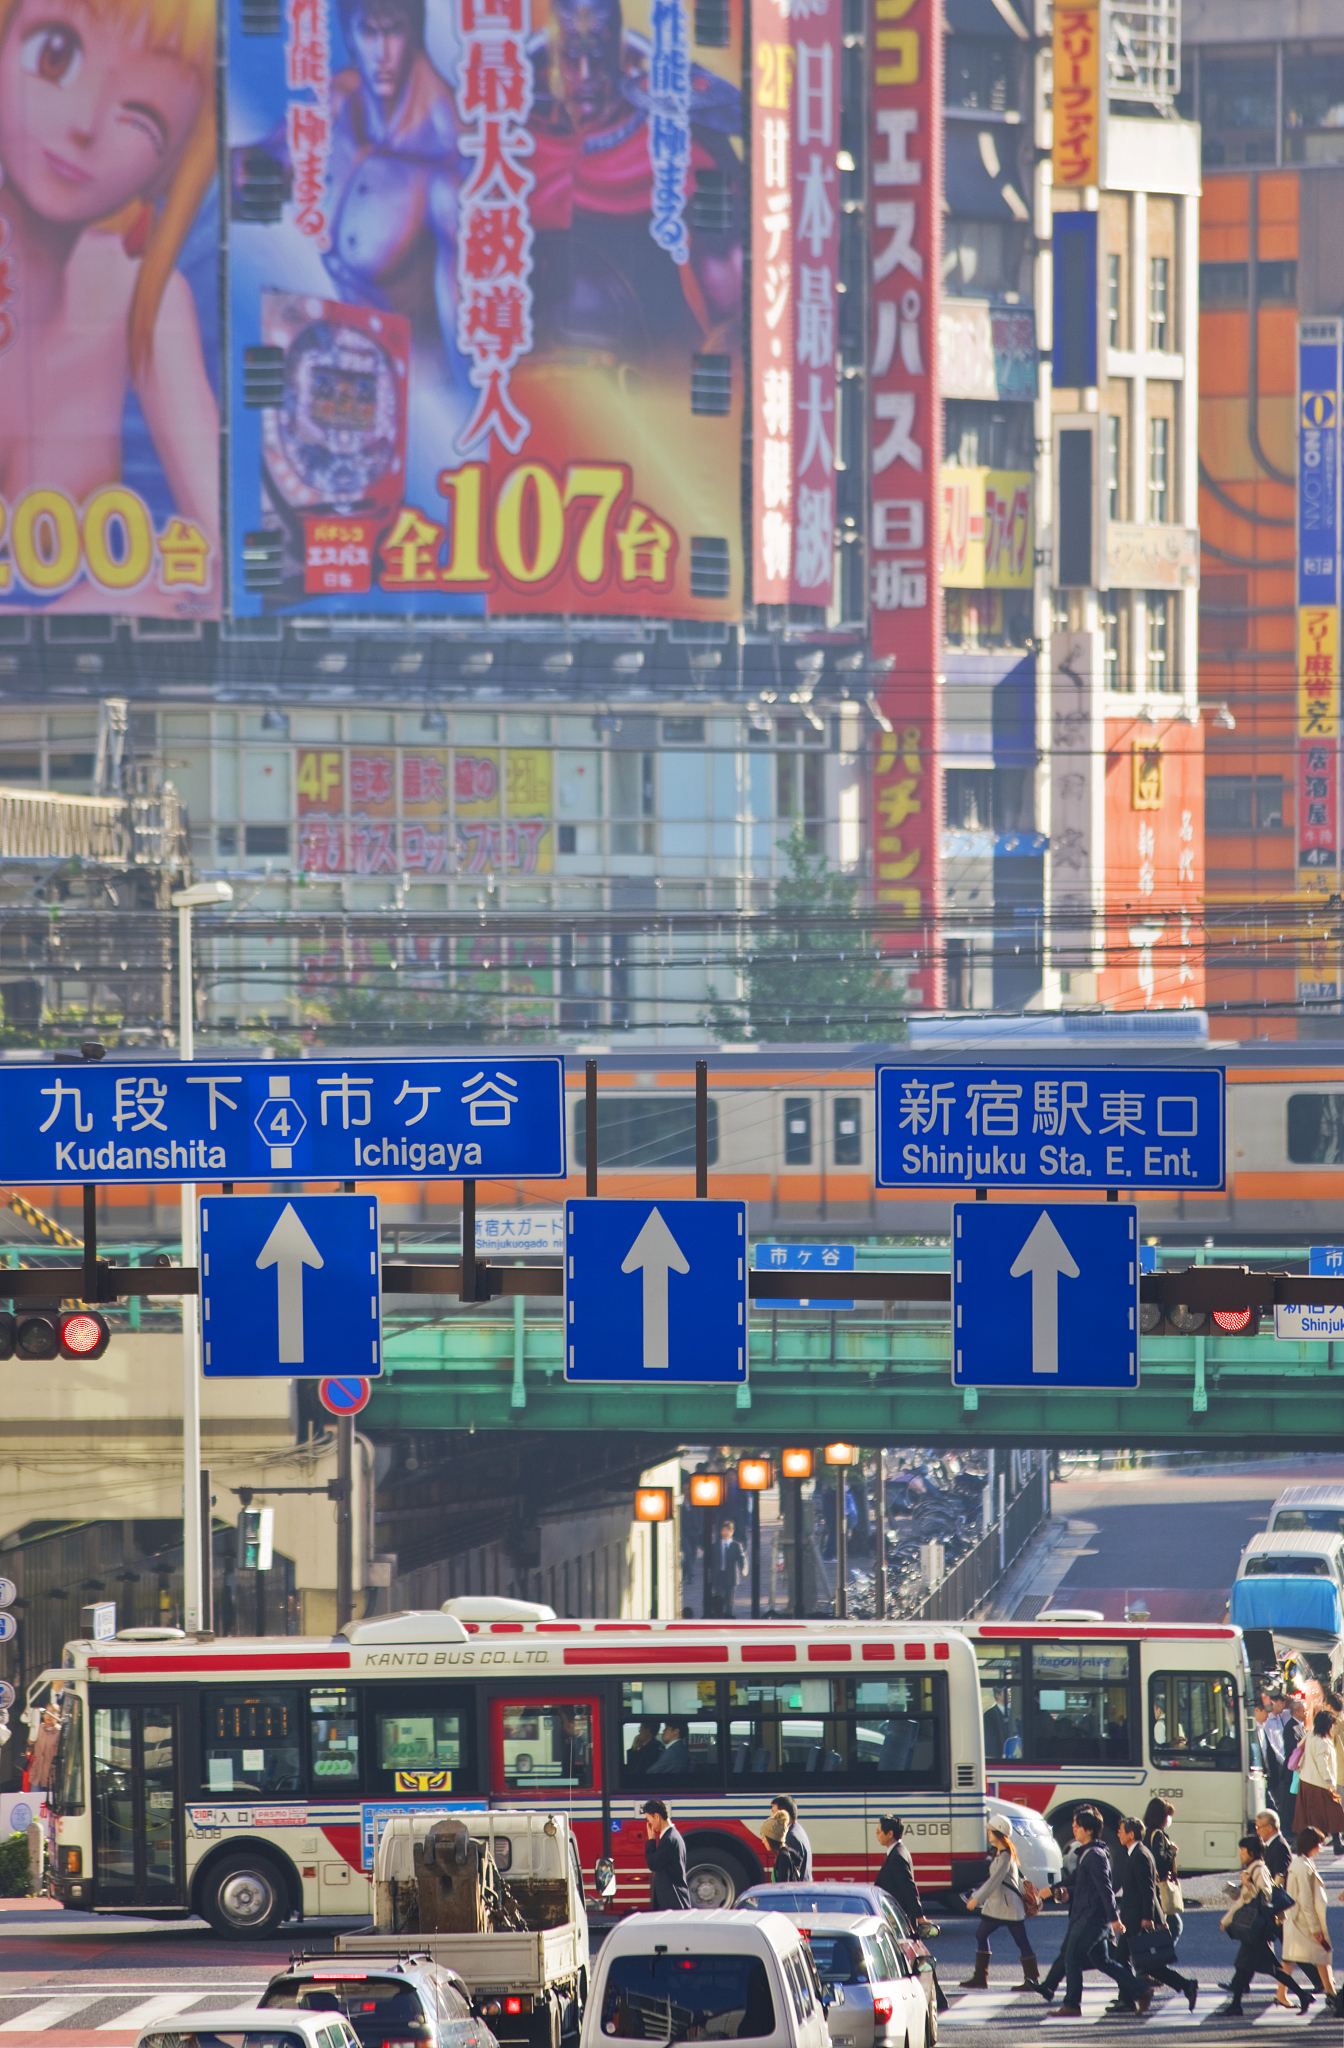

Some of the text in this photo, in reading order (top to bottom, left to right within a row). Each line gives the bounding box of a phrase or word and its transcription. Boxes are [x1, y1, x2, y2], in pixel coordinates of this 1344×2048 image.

[756, 41, 795, 110] 2F
[1060, 12, 1095, 182] スリーファイブ
[796, 40, 834, 588] 日本最大級
[0, 489, 211, 590] 00台
[384, 465, 672, 583] 全107台
[299, 753, 340, 801] 4F
[1305, 746, 1329, 826] 居酒屋
[1307, 850, 1329, 866] 4F
[39, 1077, 243, 1133] 九段下
[270, 1108, 291, 1137] 4
[899, 1078, 1198, 1137] 新宿駅東口
[55, 1139, 226, 1171] Kudanshita
[354, 1137, 483, 1171] Ichigaya
[902, 1143, 1198, 1180] Shinjuku Sta. E. Ent.
[475, 1238, 548, 1251] Shinjukuogado
[365, 1652, 428, 1666] KANTO
[433, 1651, 475, 1665] BUS
[1150, 1788, 1184, 1799] K809
[220, 1811, 248, 1823] 入口
[904, 1823, 950, 1836] A908
